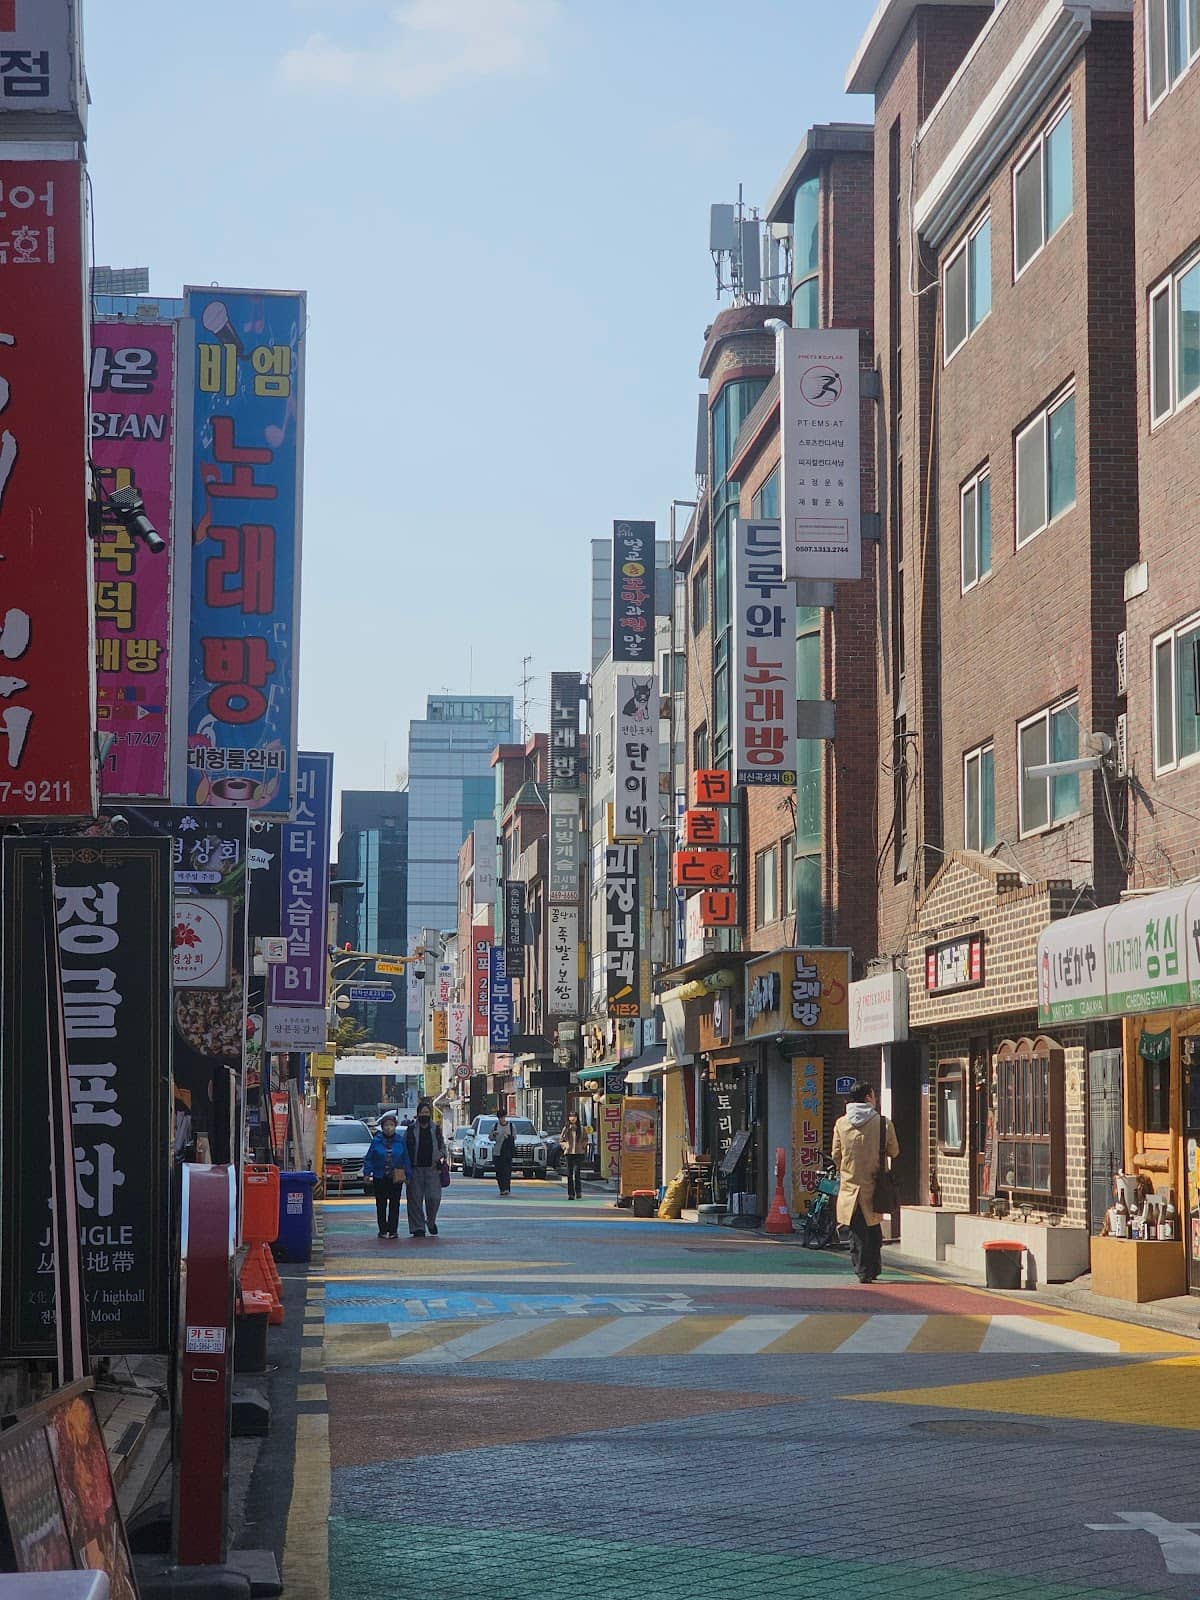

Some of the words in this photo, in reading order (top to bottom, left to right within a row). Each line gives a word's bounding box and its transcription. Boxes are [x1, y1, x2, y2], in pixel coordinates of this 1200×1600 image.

[0, 51, 49, 97] 점
[198, 343, 292, 397] 비엠
[202, 416, 277, 724] 노래방
[744, 646, 789, 765] 노래방
[186, 748, 286, 771] 대형룸완비
[554, 700, 576, 777] 노래방
[624, 743, 648, 832] 탄이네
[286, 867, 313, 957] 연습실
[1053, 943, 1096, 989] いざかや
[1146, 914, 1179, 979] 청심
[284, 965, 312, 990] B1
[793, 956, 821, 1026] 노래방
[492, 984, 510, 1042] 부동산
[801, 1120, 818, 1192] 노래방
[91, 1308, 121, 1322] Mood
[103, 1288, 145, 1305] highball
